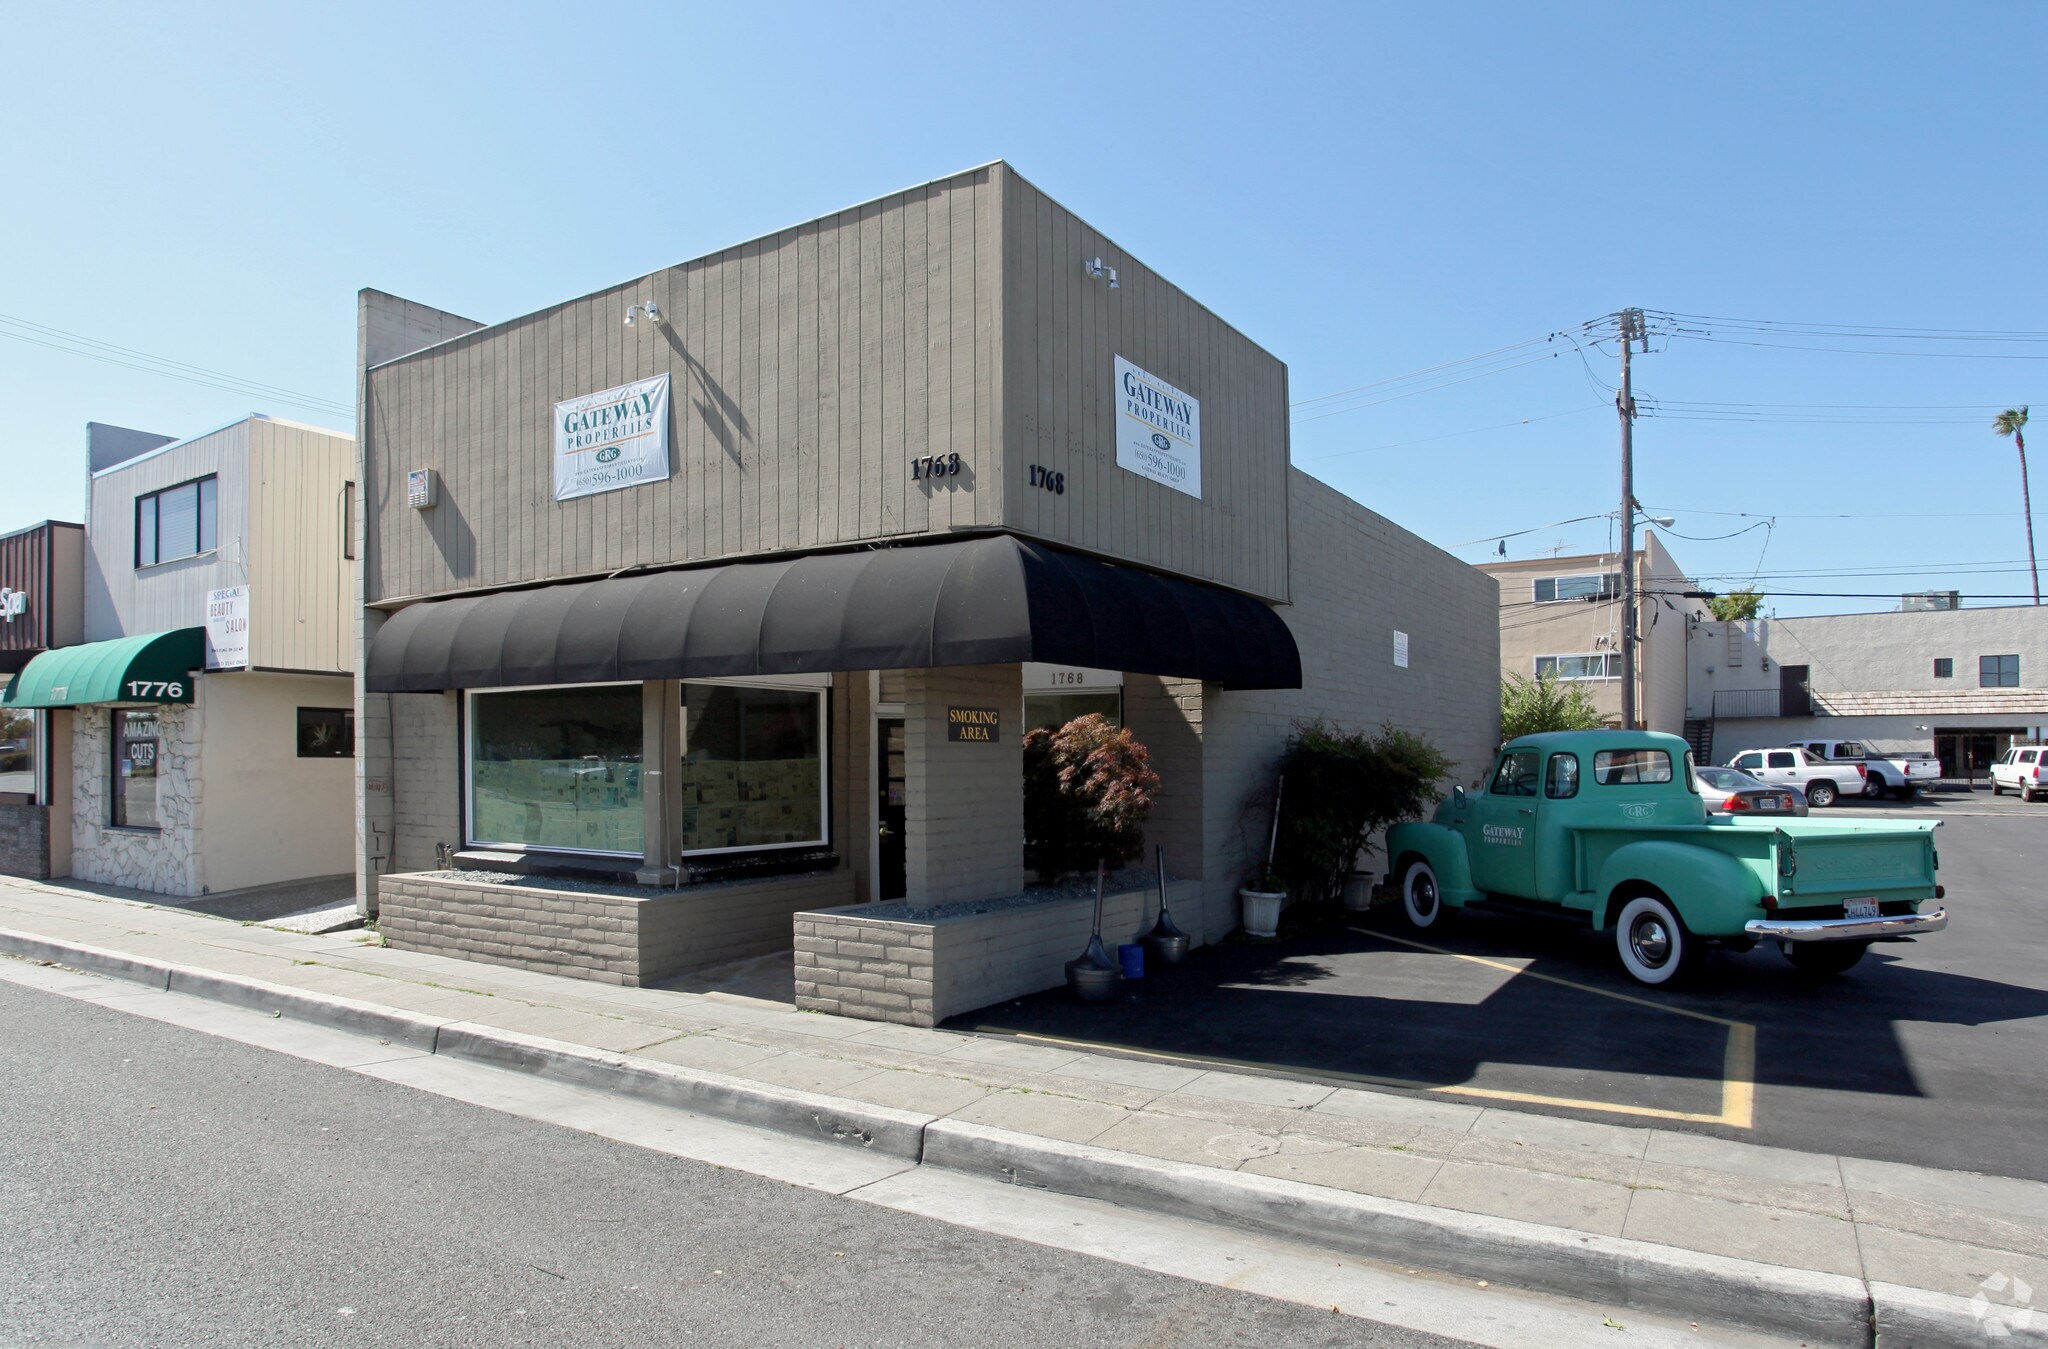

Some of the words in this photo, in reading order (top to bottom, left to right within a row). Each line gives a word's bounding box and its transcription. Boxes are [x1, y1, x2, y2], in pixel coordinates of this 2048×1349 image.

[1123, 371, 1191, 426] GATEWAY
[564, 391, 656, 434] GATEWAY
[1127, 399, 1192, 441] PROPERTIES
[567, 417, 652, 449] PROPERTIES
[1154, 434, 1169, 450] GRG
[599, 448, 617, 462] GRG
[911, 452, 961, 480] 1768
[1029, 464, 1065, 495] 1768
[0, 587, 27, 623] Spa
[210, 601, 233, 617] BEAUTY
[226, 617, 247, 634] SALON
[1051, 672, 1083, 685] 1768
[127, 680, 183, 698] 1776
[949, 709, 998, 725] SMOKING
[960, 727, 989, 740] AREA
[131, 743, 154, 760] CUTS
[1628, 806, 1649, 817] GRG
[1482, 823, 1525, 839] GATEWAY
[1483, 836, 1522, 846] PROPERTIES
